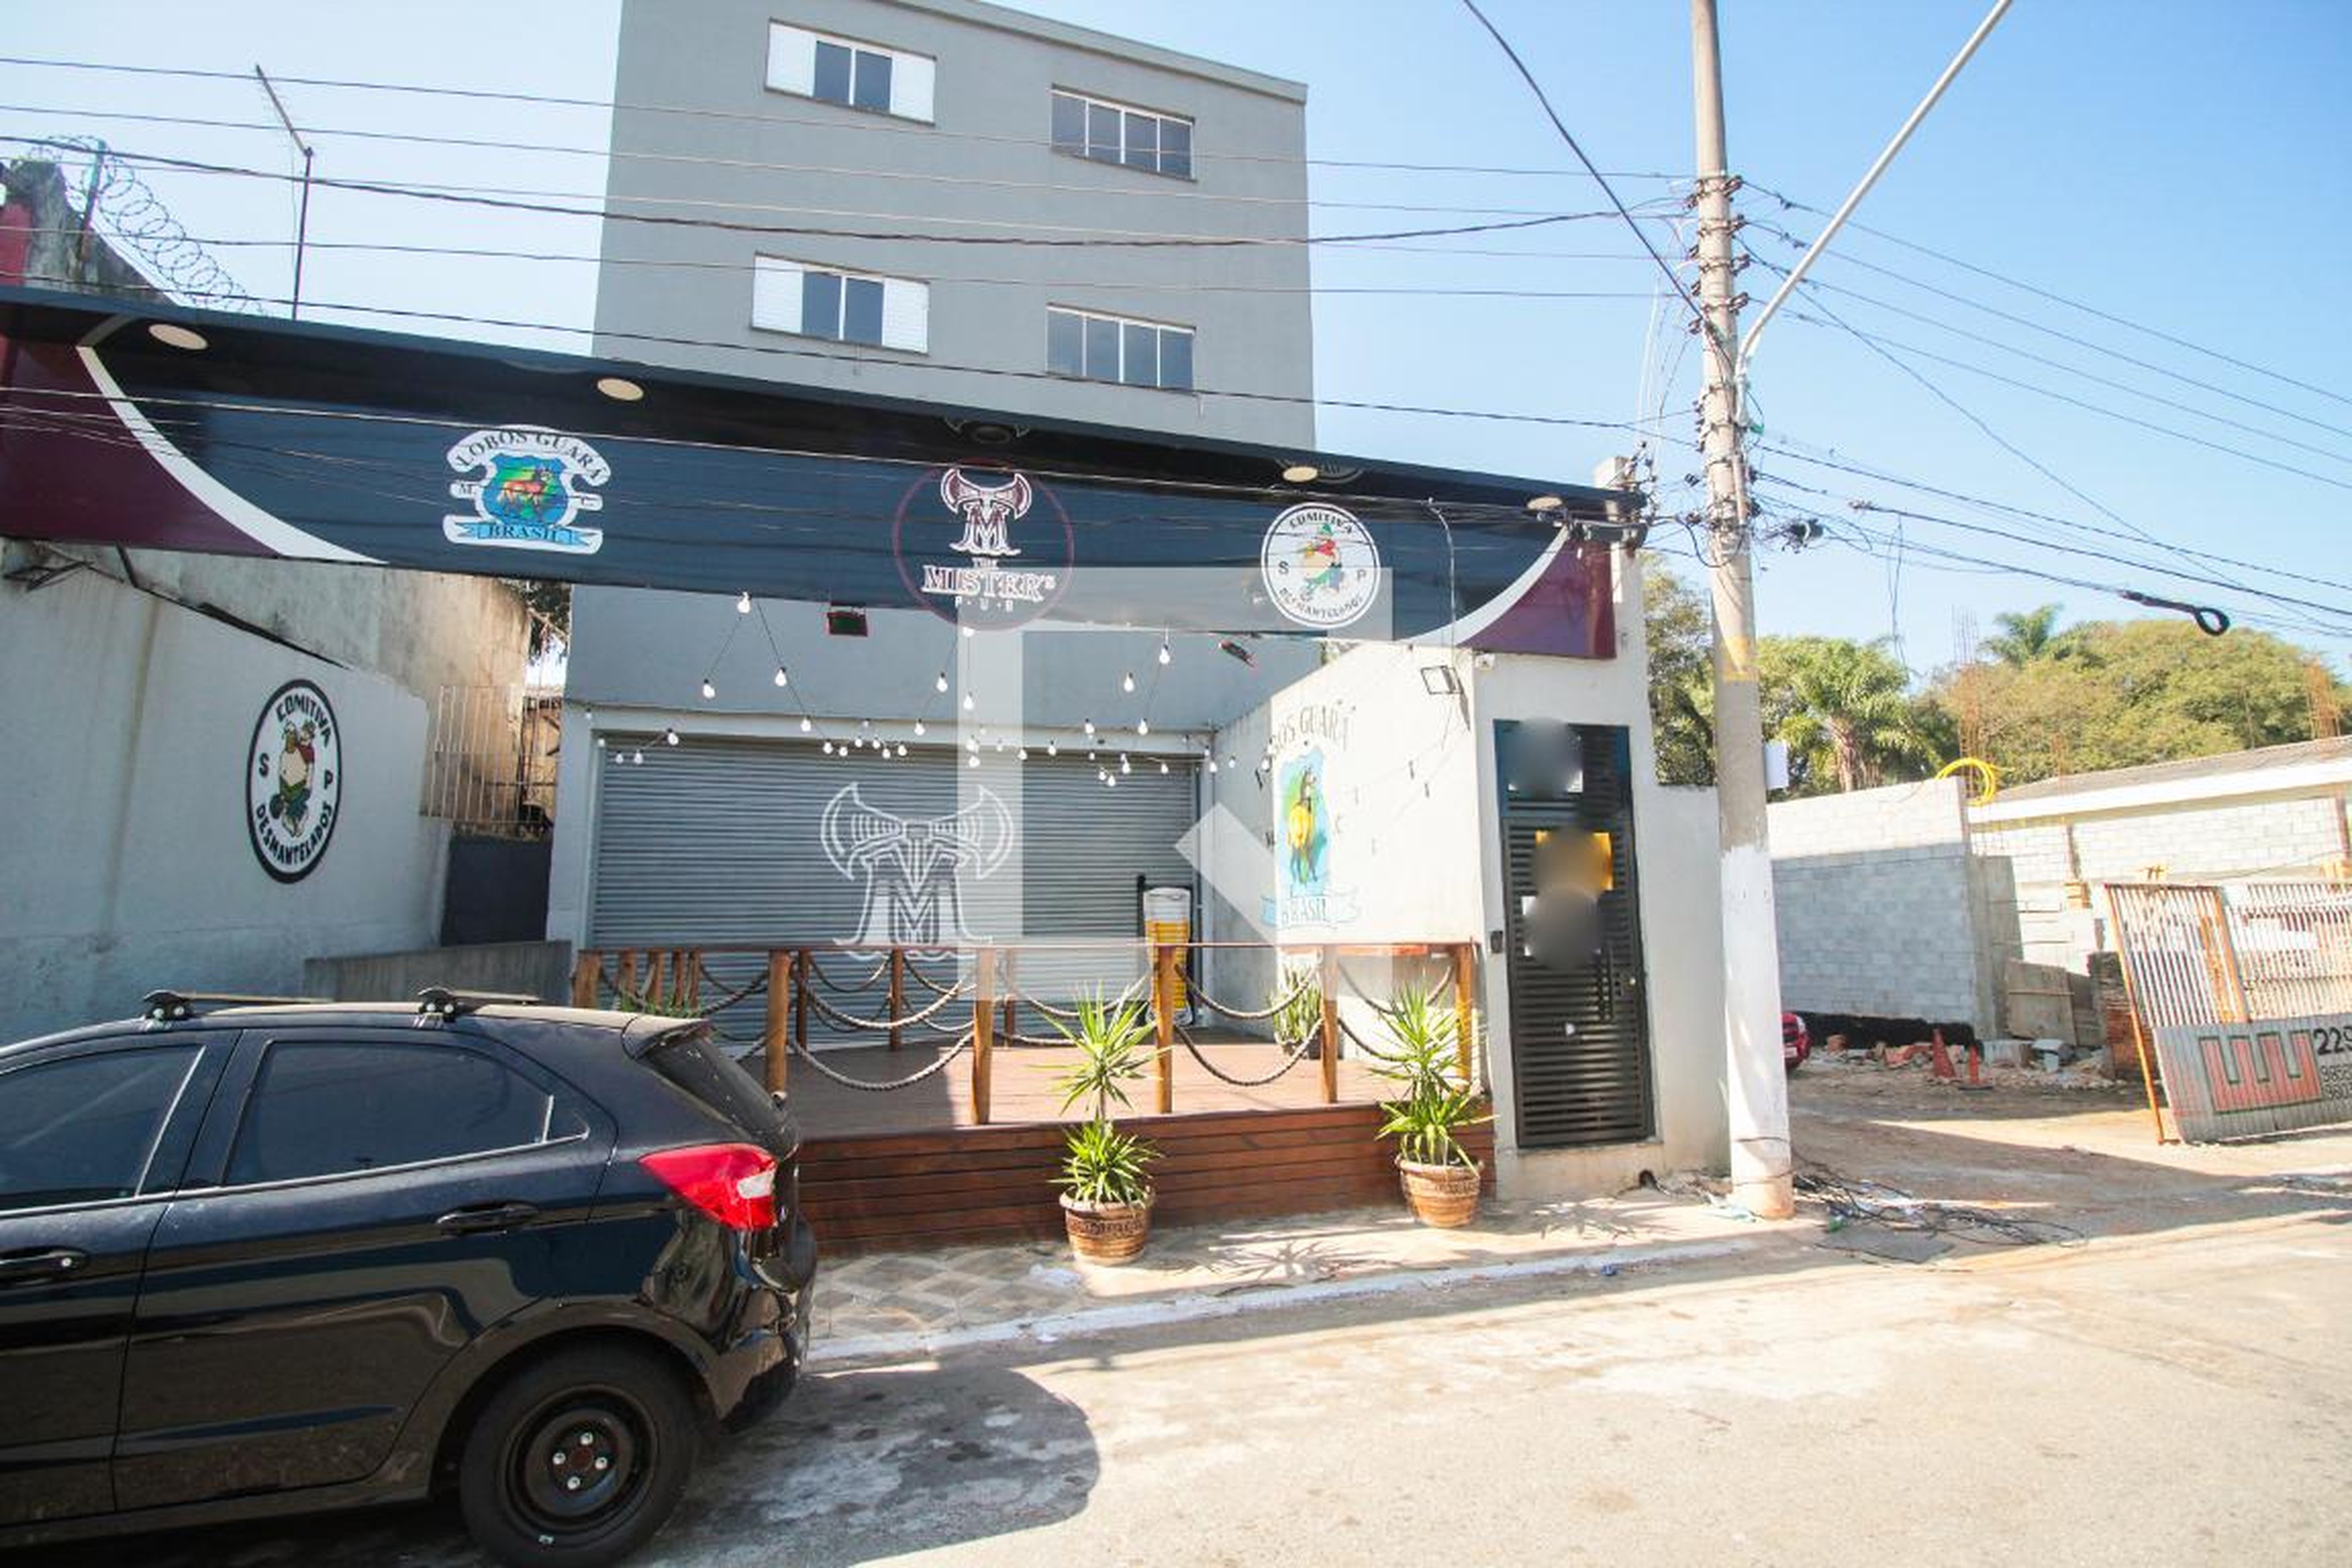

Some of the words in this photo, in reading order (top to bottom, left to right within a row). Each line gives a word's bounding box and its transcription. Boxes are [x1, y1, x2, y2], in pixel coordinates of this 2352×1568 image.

[456, 430, 527, 467] LOBOS
[1279, 560, 1289, 575] S
[1357, 569, 1367, 581] P
[276, 693, 332, 748] COMITIVA
[258, 752, 270, 778] S
[324, 769, 334, 791] P
[256, 799, 333, 866] DESMANTELADOS
